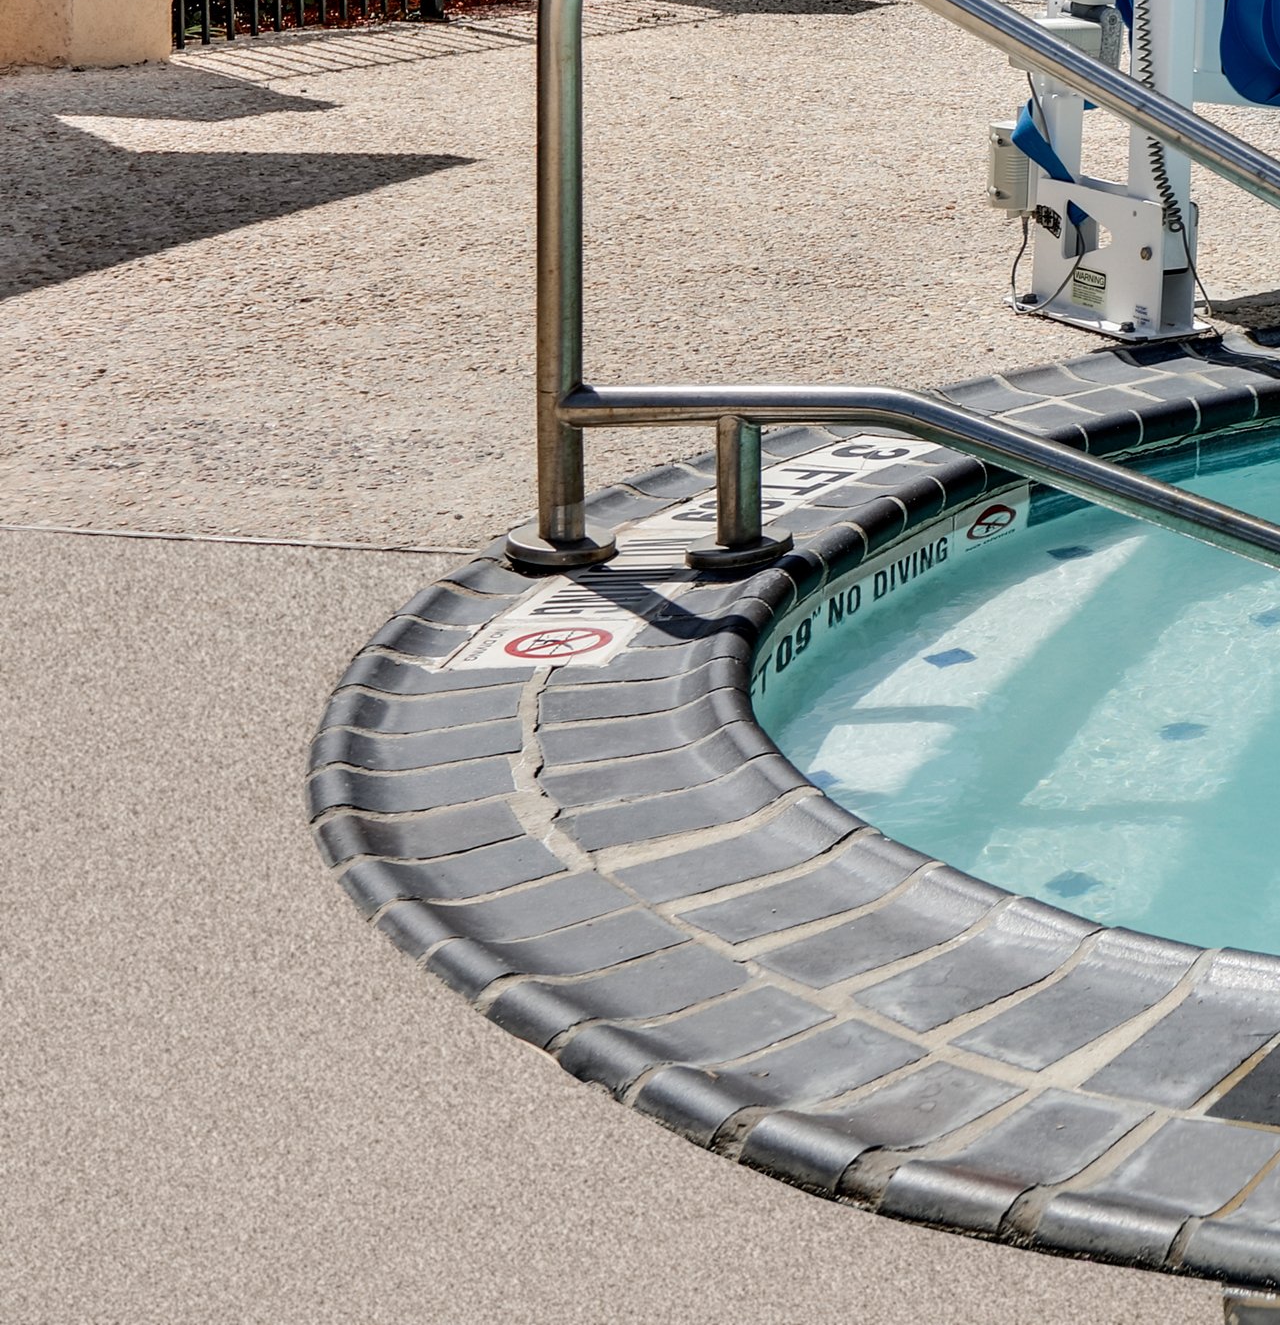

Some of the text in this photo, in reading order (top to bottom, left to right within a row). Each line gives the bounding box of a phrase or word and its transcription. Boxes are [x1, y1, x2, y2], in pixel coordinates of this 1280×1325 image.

[1075, 270, 1105, 285] WARNING
[831, 444, 910, 460] 3
[757, 467, 856, 496] FT
[621, 538, 694, 556] NO
[529, 564, 678, 616] DIVING
[828, 585, 861, 628] NO
[873, 536, 949, 602] DIVING
